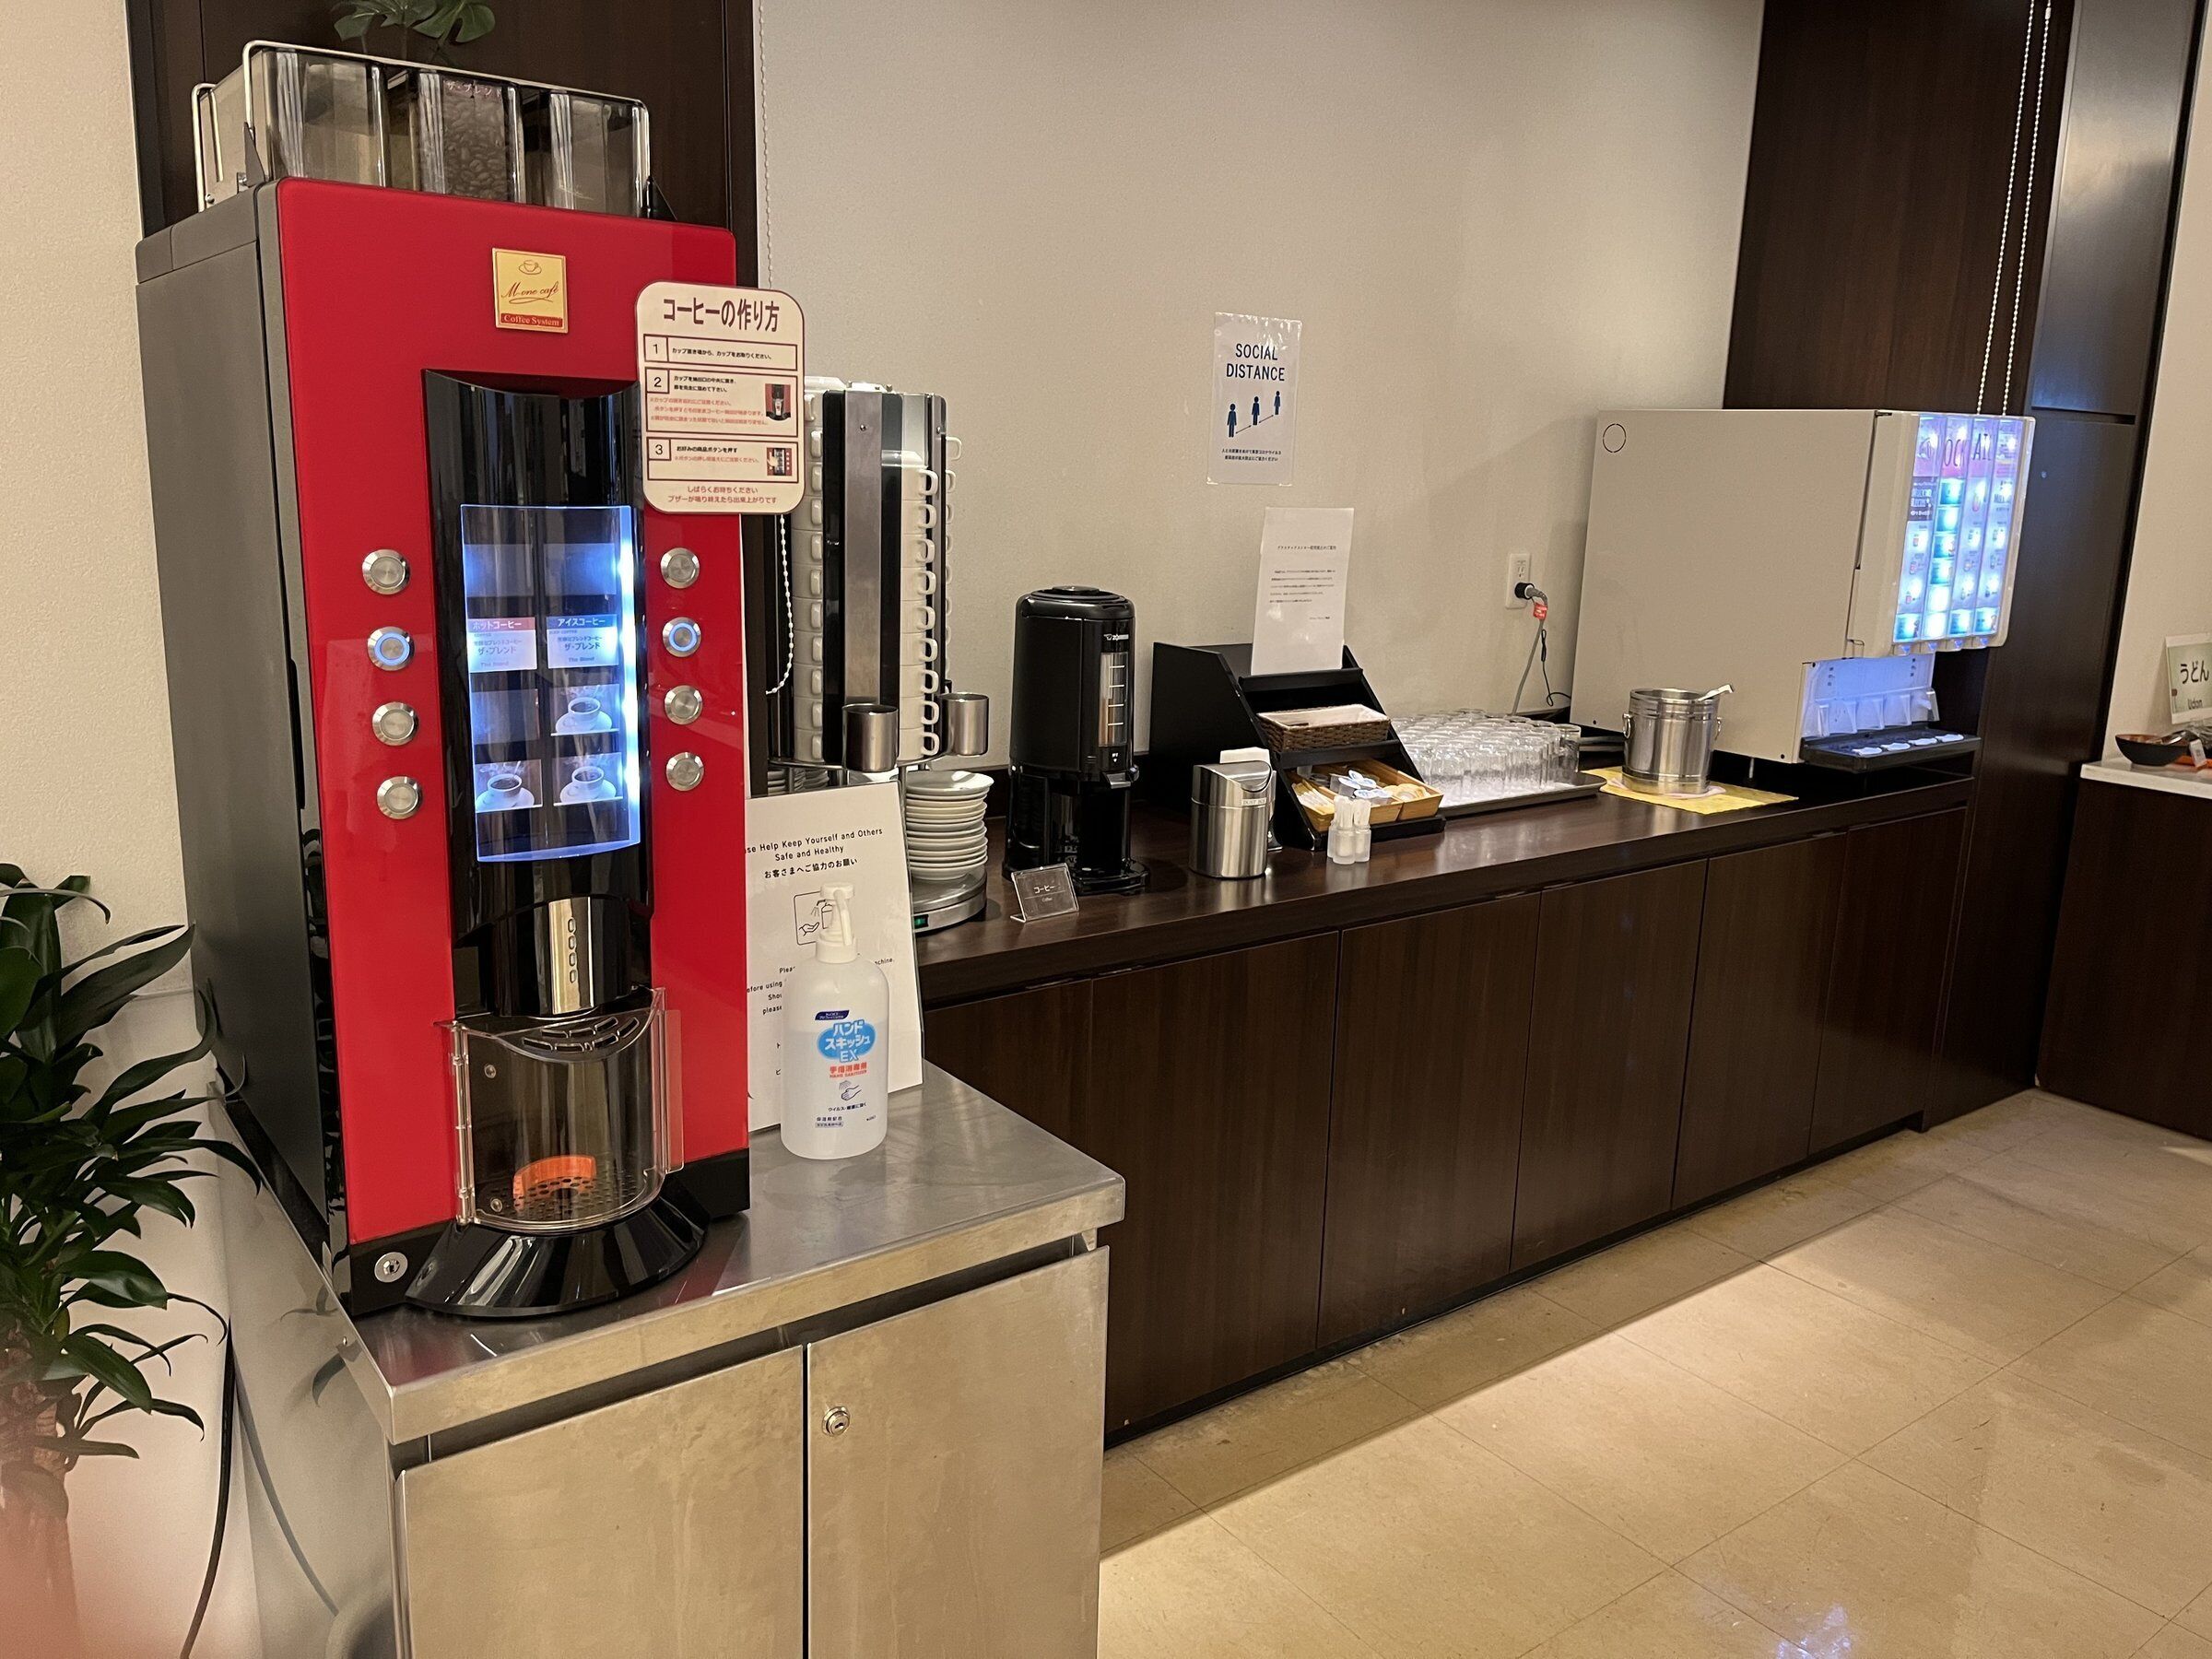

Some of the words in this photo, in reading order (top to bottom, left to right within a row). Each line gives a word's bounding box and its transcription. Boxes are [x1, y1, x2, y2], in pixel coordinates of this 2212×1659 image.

[503, 314, 531, 324] Coffee
[531, 316, 559, 326] System
[663, 297, 780, 332] コーヒーの作り方
[653, 343, 659, 354] 1
[1235, 343, 1278, 360] SOCIAL
[1226, 363, 1286, 382] DISTANCE
[653, 376, 663, 388] 2
[654, 444, 664, 455] 3
[687, 486, 759, 494] しばらくお待ちください
[472, 620, 523, 630] ホットコーヒー
[558, 618, 606, 627] アイスコーヒー
[477, 645, 517, 656] ザ・ブレンド
[564, 642, 601, 651] ザ・ブレンド
[2180, 660, 2210, 684] うどん
[2187, 698, 2203, 710] Udon
[759, 841, 779, 852] Help
[782, 839, 803, 849] Keep
[806, 833, 839, 845] Yourself
[841, 830, 855, 840] and
[857, 828, 883, 838] Others
[775, 853, 794, 862] Safe
[796, 850, 811, 858] and
[814, 845, 844, 855] Healthy
[764, 858, 858, 878] お客さまへご協力のお願い
[1033, 885, 1055, 894] コーヒー
[765, 981, 782, 989] using
[832, 1020, 865, 1037] ハンド
[824, 1034, 871, 1051] スキッシュ
[840, 1049, 858, 1062] EX
